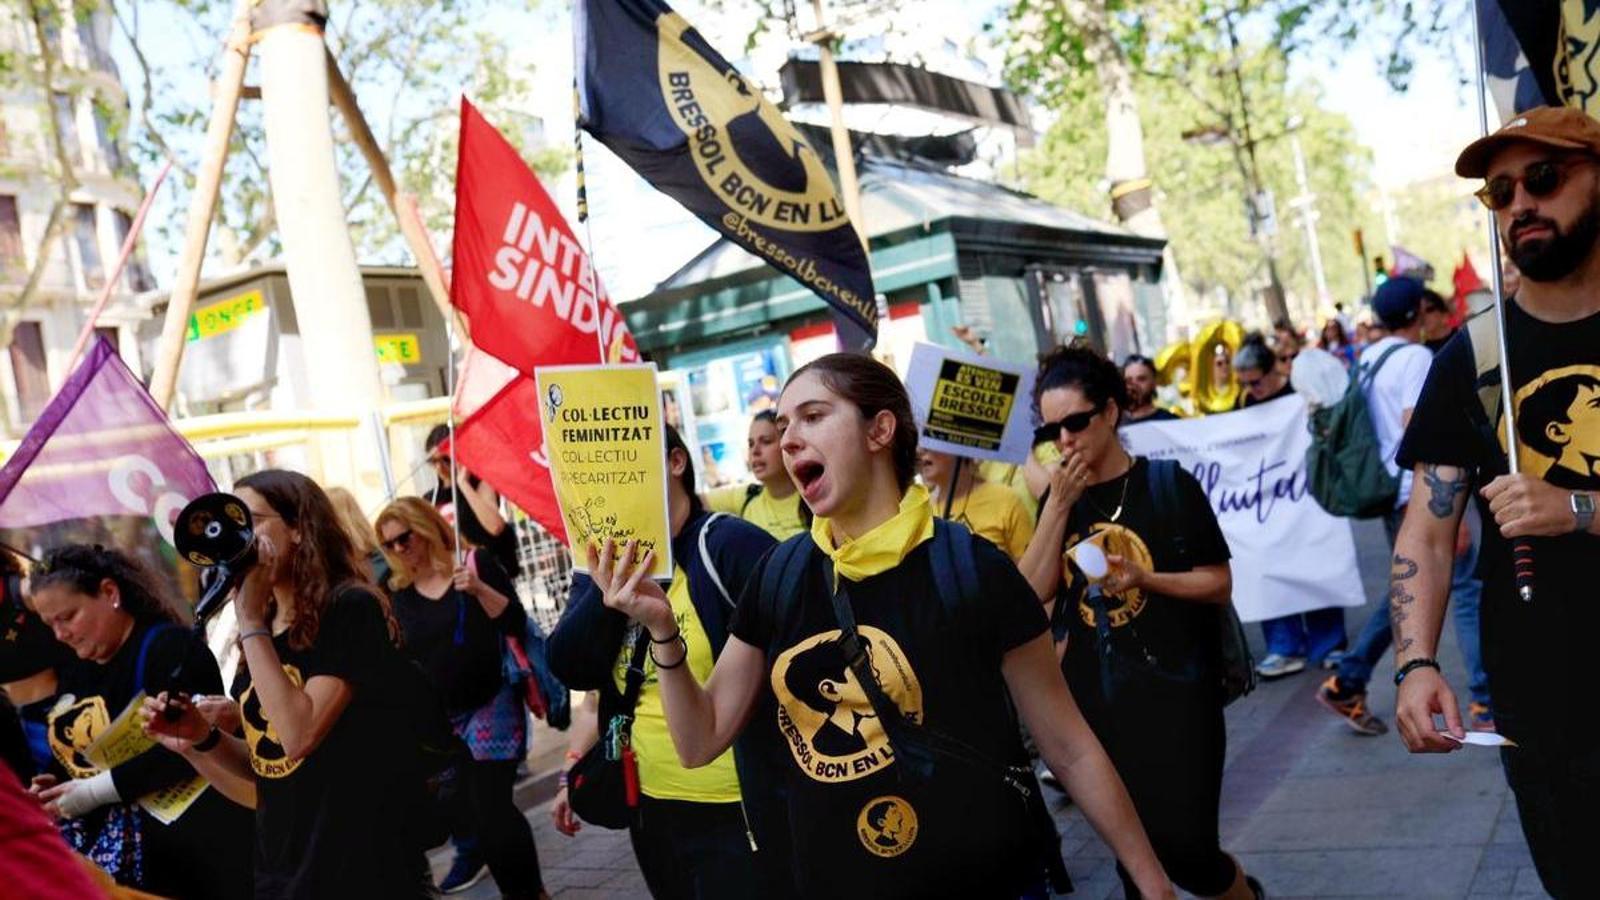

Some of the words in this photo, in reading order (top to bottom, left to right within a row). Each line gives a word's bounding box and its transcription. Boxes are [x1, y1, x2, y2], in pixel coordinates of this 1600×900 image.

[668, 72, 728, 176] BRESSOL
[720, 172, 771, 215] BCN
[773, 202, 810, 225] EN
[943, 383, 1006, 408] ESCOLES
[562, 406, 649, 422] COL·LECTIU
[938, 396, 1003, 421] BRESSOL
[562, 426, 652, 443] FEMINITZAT
[815, 761, 848, 777] BCN
[853, 753, 879, 774] EN
